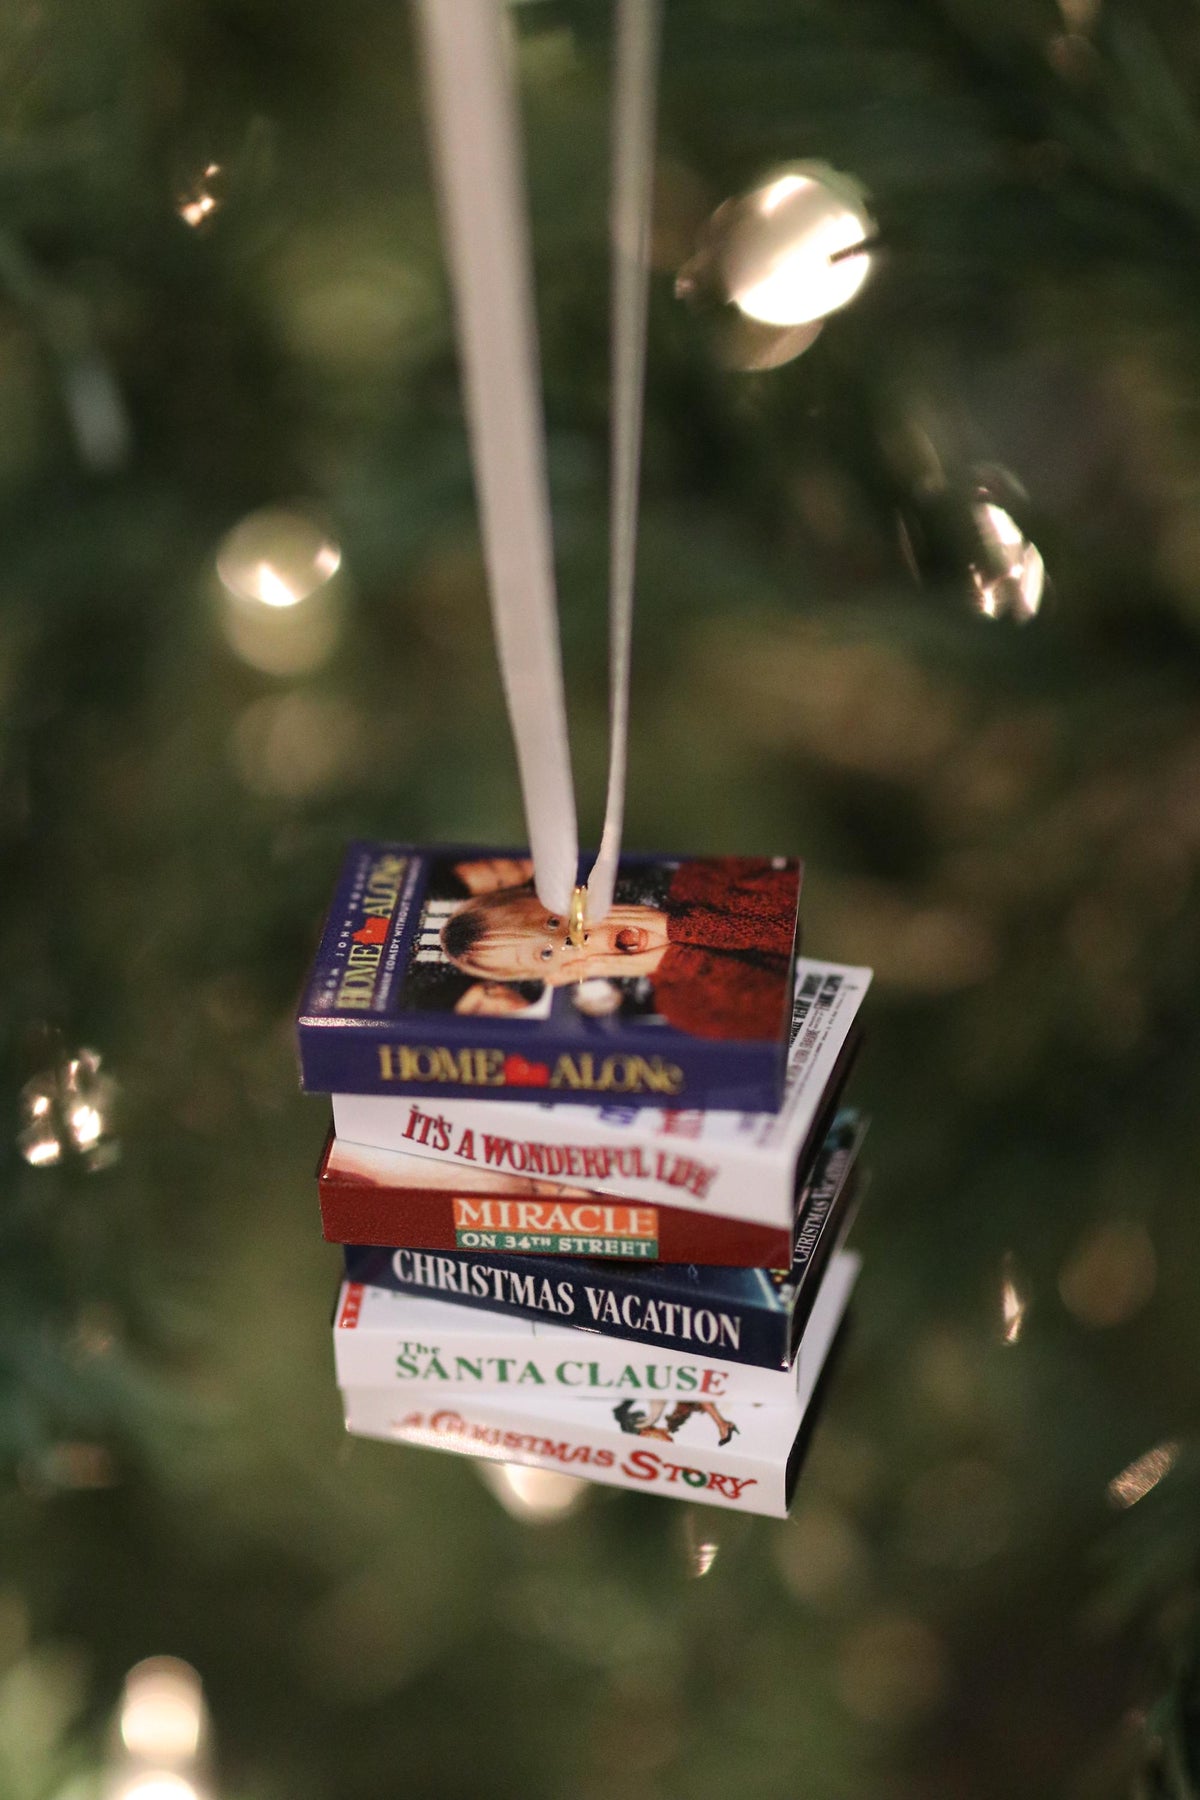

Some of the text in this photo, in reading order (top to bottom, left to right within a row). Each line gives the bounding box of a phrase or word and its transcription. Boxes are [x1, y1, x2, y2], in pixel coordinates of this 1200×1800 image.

[335, 920, 353, 957] JOHN
[384, 938, 402, 971] COMEDY
[334, 944, 384, 1010] HOME
[378, 1044, 506, 1087] HOME
[401, 1104, 452, 1152] IT'S
[454, 1128, 477, 1162] A
[482, 1133, 650, 1180] WONDERFUL
[457, 1200, 656, 1235] MIRACLE
[793, 1199, 831, 1263] CHRISTMAS
[461, 1232, 652, 1257] ON 34TH STREET
[392, 1248, 576, 1316] CHRISTMAS
[584, 1286, 742, 1350] VACATION
[398, 1341, 441, 1356] The
[395, 1353, 731, 1397] SANTA CLAUSE
[621, 1449, 758, 1500] STORY
